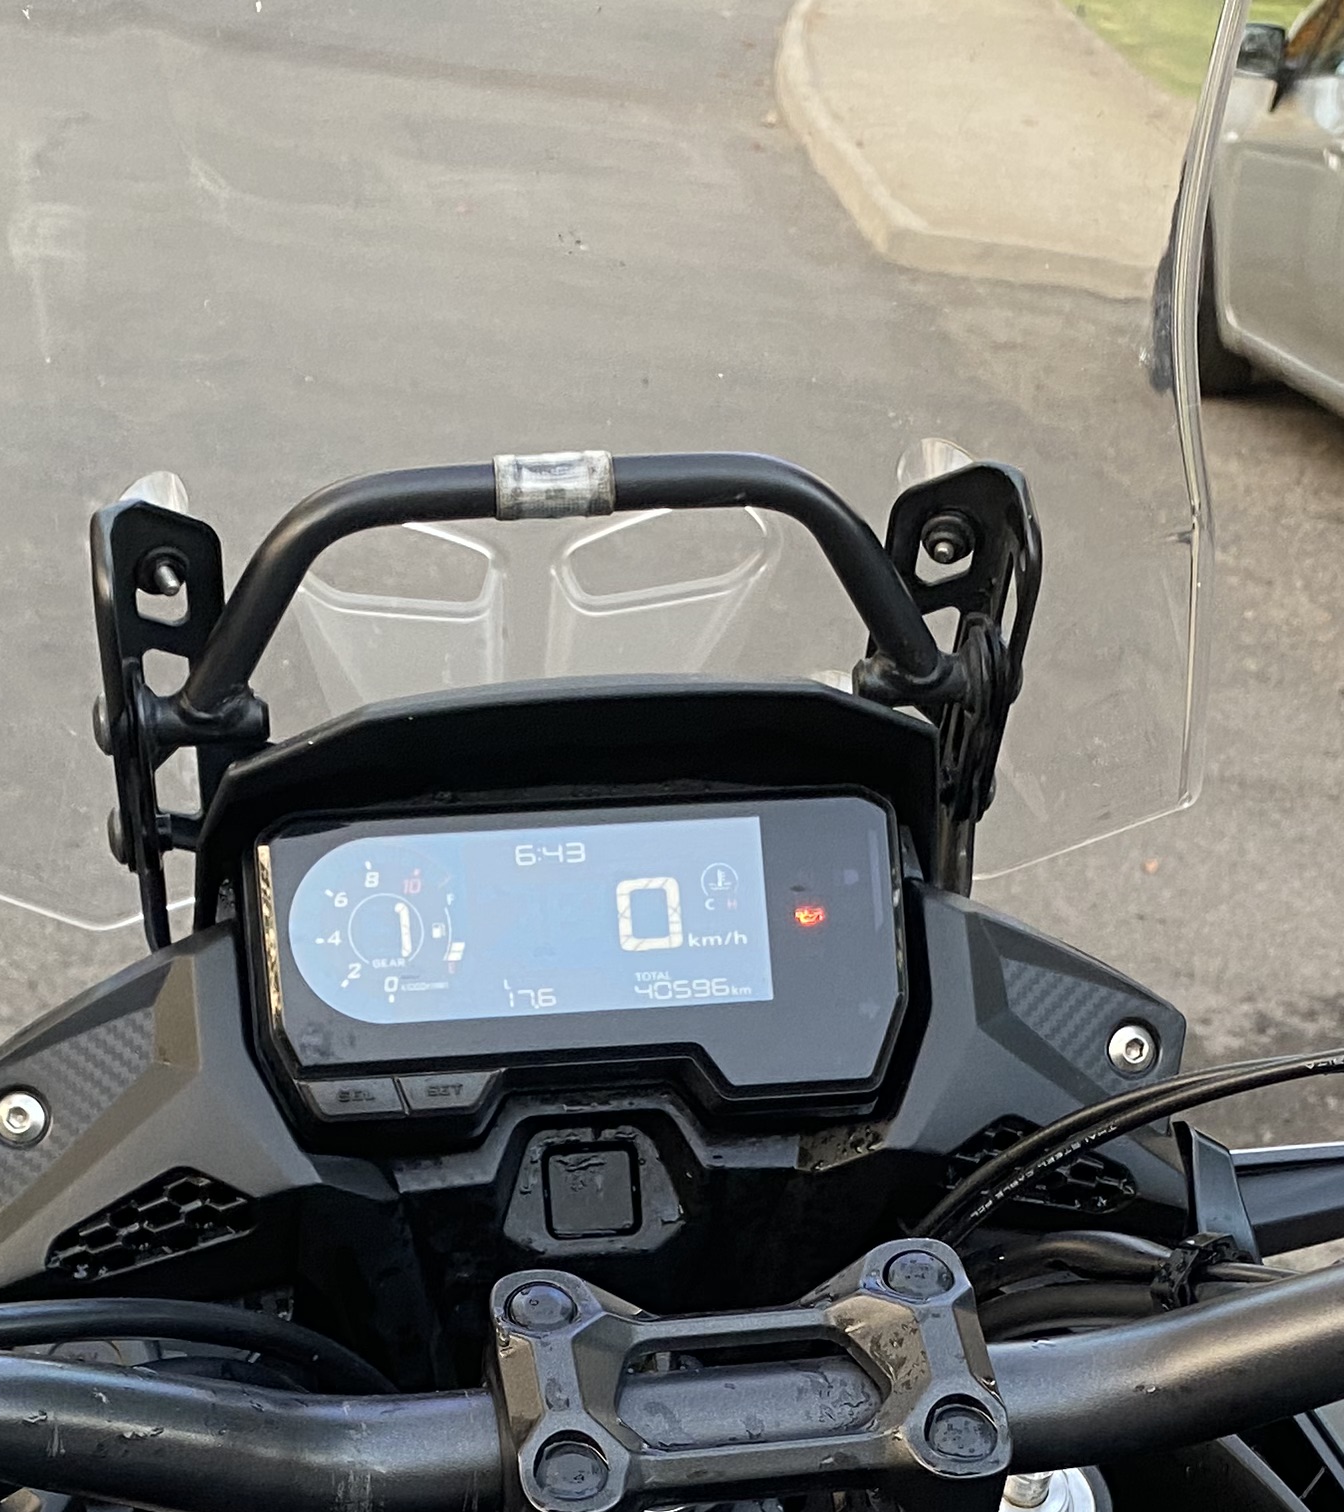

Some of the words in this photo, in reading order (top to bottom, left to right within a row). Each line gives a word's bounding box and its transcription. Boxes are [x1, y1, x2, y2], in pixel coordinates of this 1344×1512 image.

[515, 842, 587, 866] 6:43
[364, 872, 380, 888] 8
[403, 878, 422, 895] 10
[334, 892, 348, 908] 6
[616, 876, 684, 952] 0
[688, 930, 748, 948] km/h
[327, 930, 343, 946] 4
[347, 963, 362, 979] 2
[372, 958, 406, 969] GEAR
[384, 976, 399, 992] 0
[634, 971, 672, 982] TOTAL
[634, 978, 730, 1001] 40596
[730, 985, 753, 996] km
